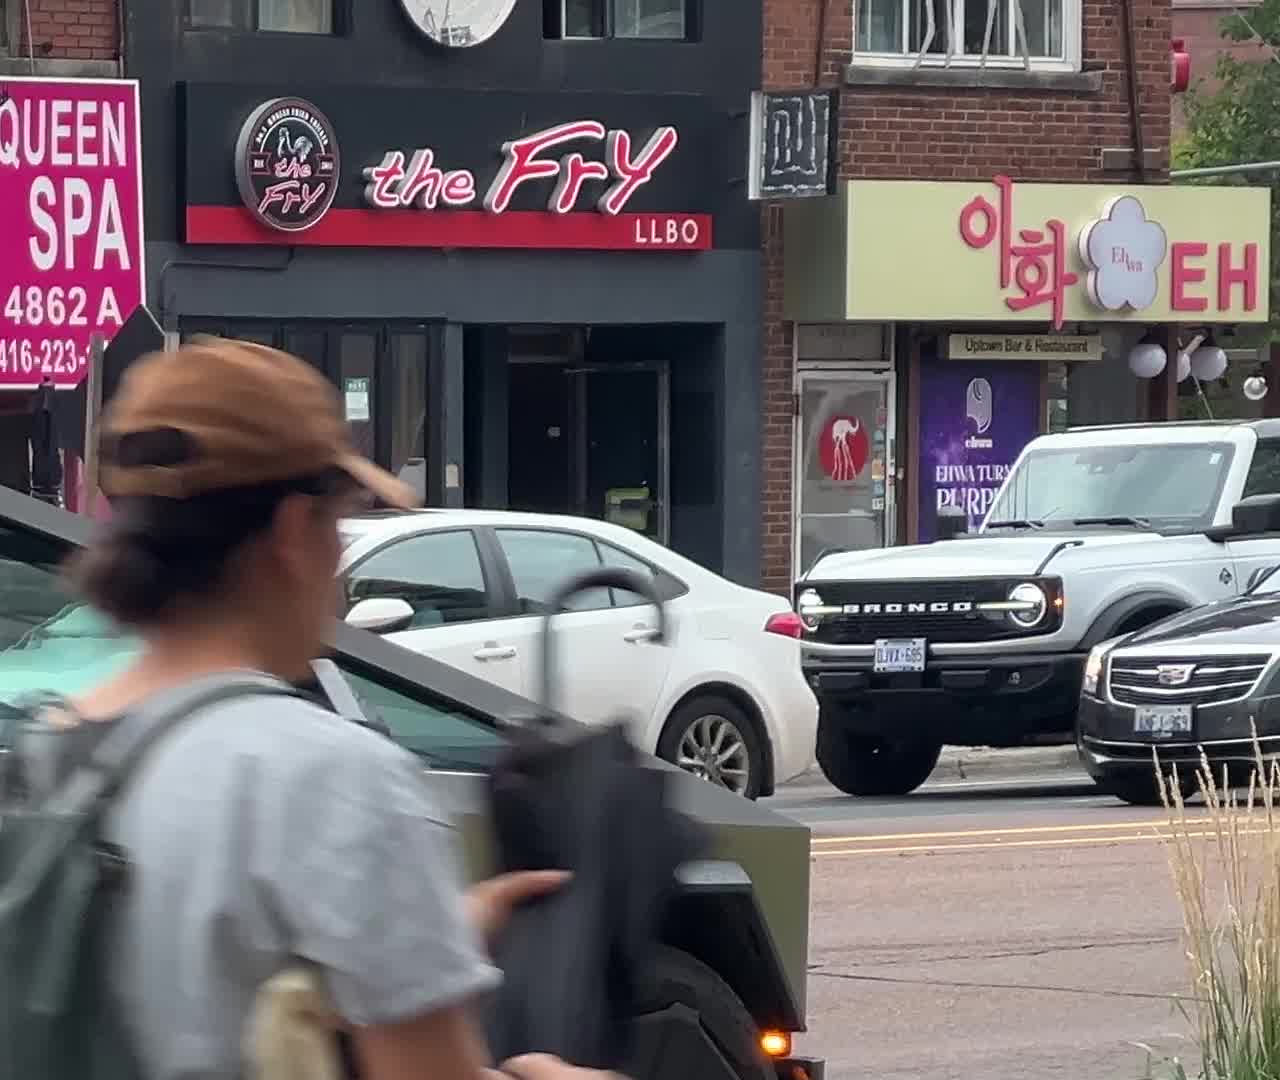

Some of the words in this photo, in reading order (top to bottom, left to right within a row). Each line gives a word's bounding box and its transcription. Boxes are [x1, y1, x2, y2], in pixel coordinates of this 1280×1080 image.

[363, 149, 476, 208] the
[29, 175, 131, 271] SPA
[635, 219, 698, 243] LLBO
[960, 175, 1079, 331] 이화
[1171, 242, 1258, 312] EH
[4, 285, 88, 326] 4862
[96, 286, 124, 326] A
[937, 487, 1000, 515] PURP
[843, 601, 972, 614] BRONCO
